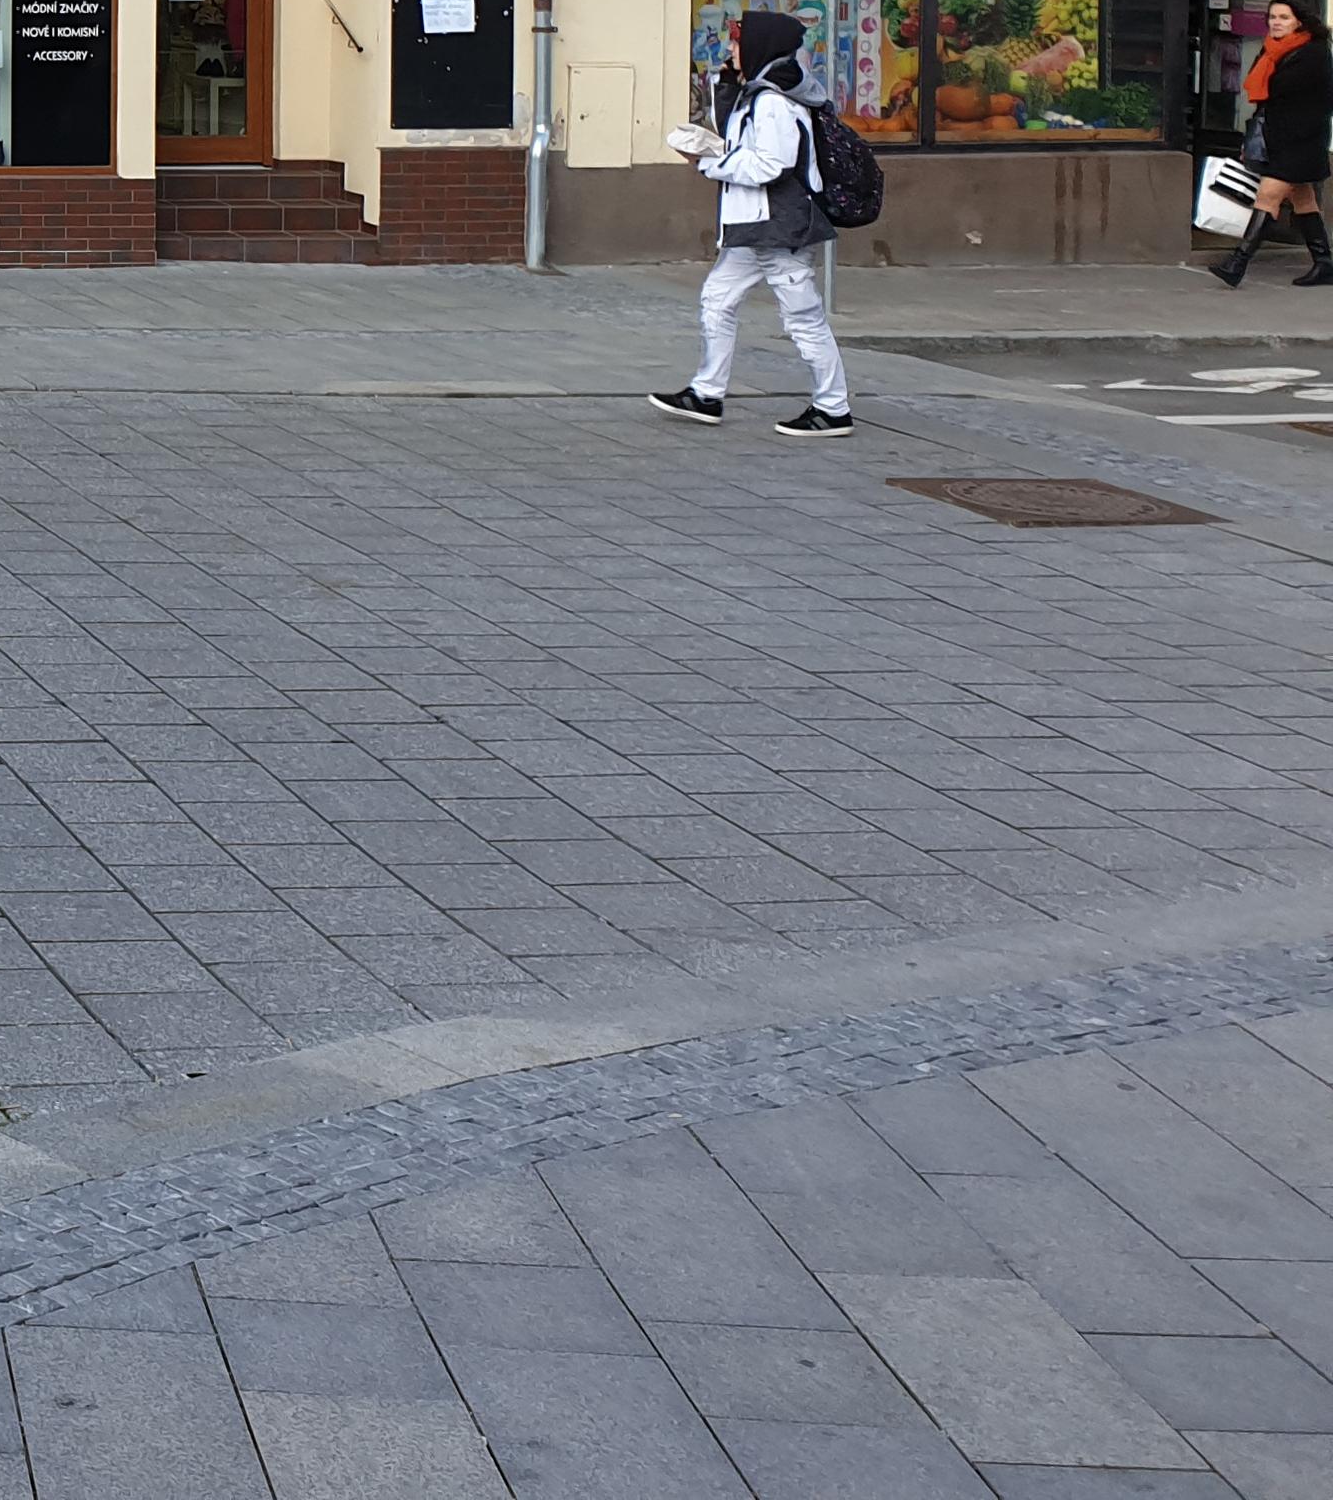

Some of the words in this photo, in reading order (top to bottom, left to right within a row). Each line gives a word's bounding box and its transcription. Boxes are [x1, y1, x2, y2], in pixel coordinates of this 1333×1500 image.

[21, 0, 58, 14] MÓDNÍ
[59, 0, 99, 14] ZNAČKY
[22, 24, 50, 38] NOVÉ
[57, 24, 99, 38] KOMISNÍ
[33, 51, 89, 61] ACCESSORY
